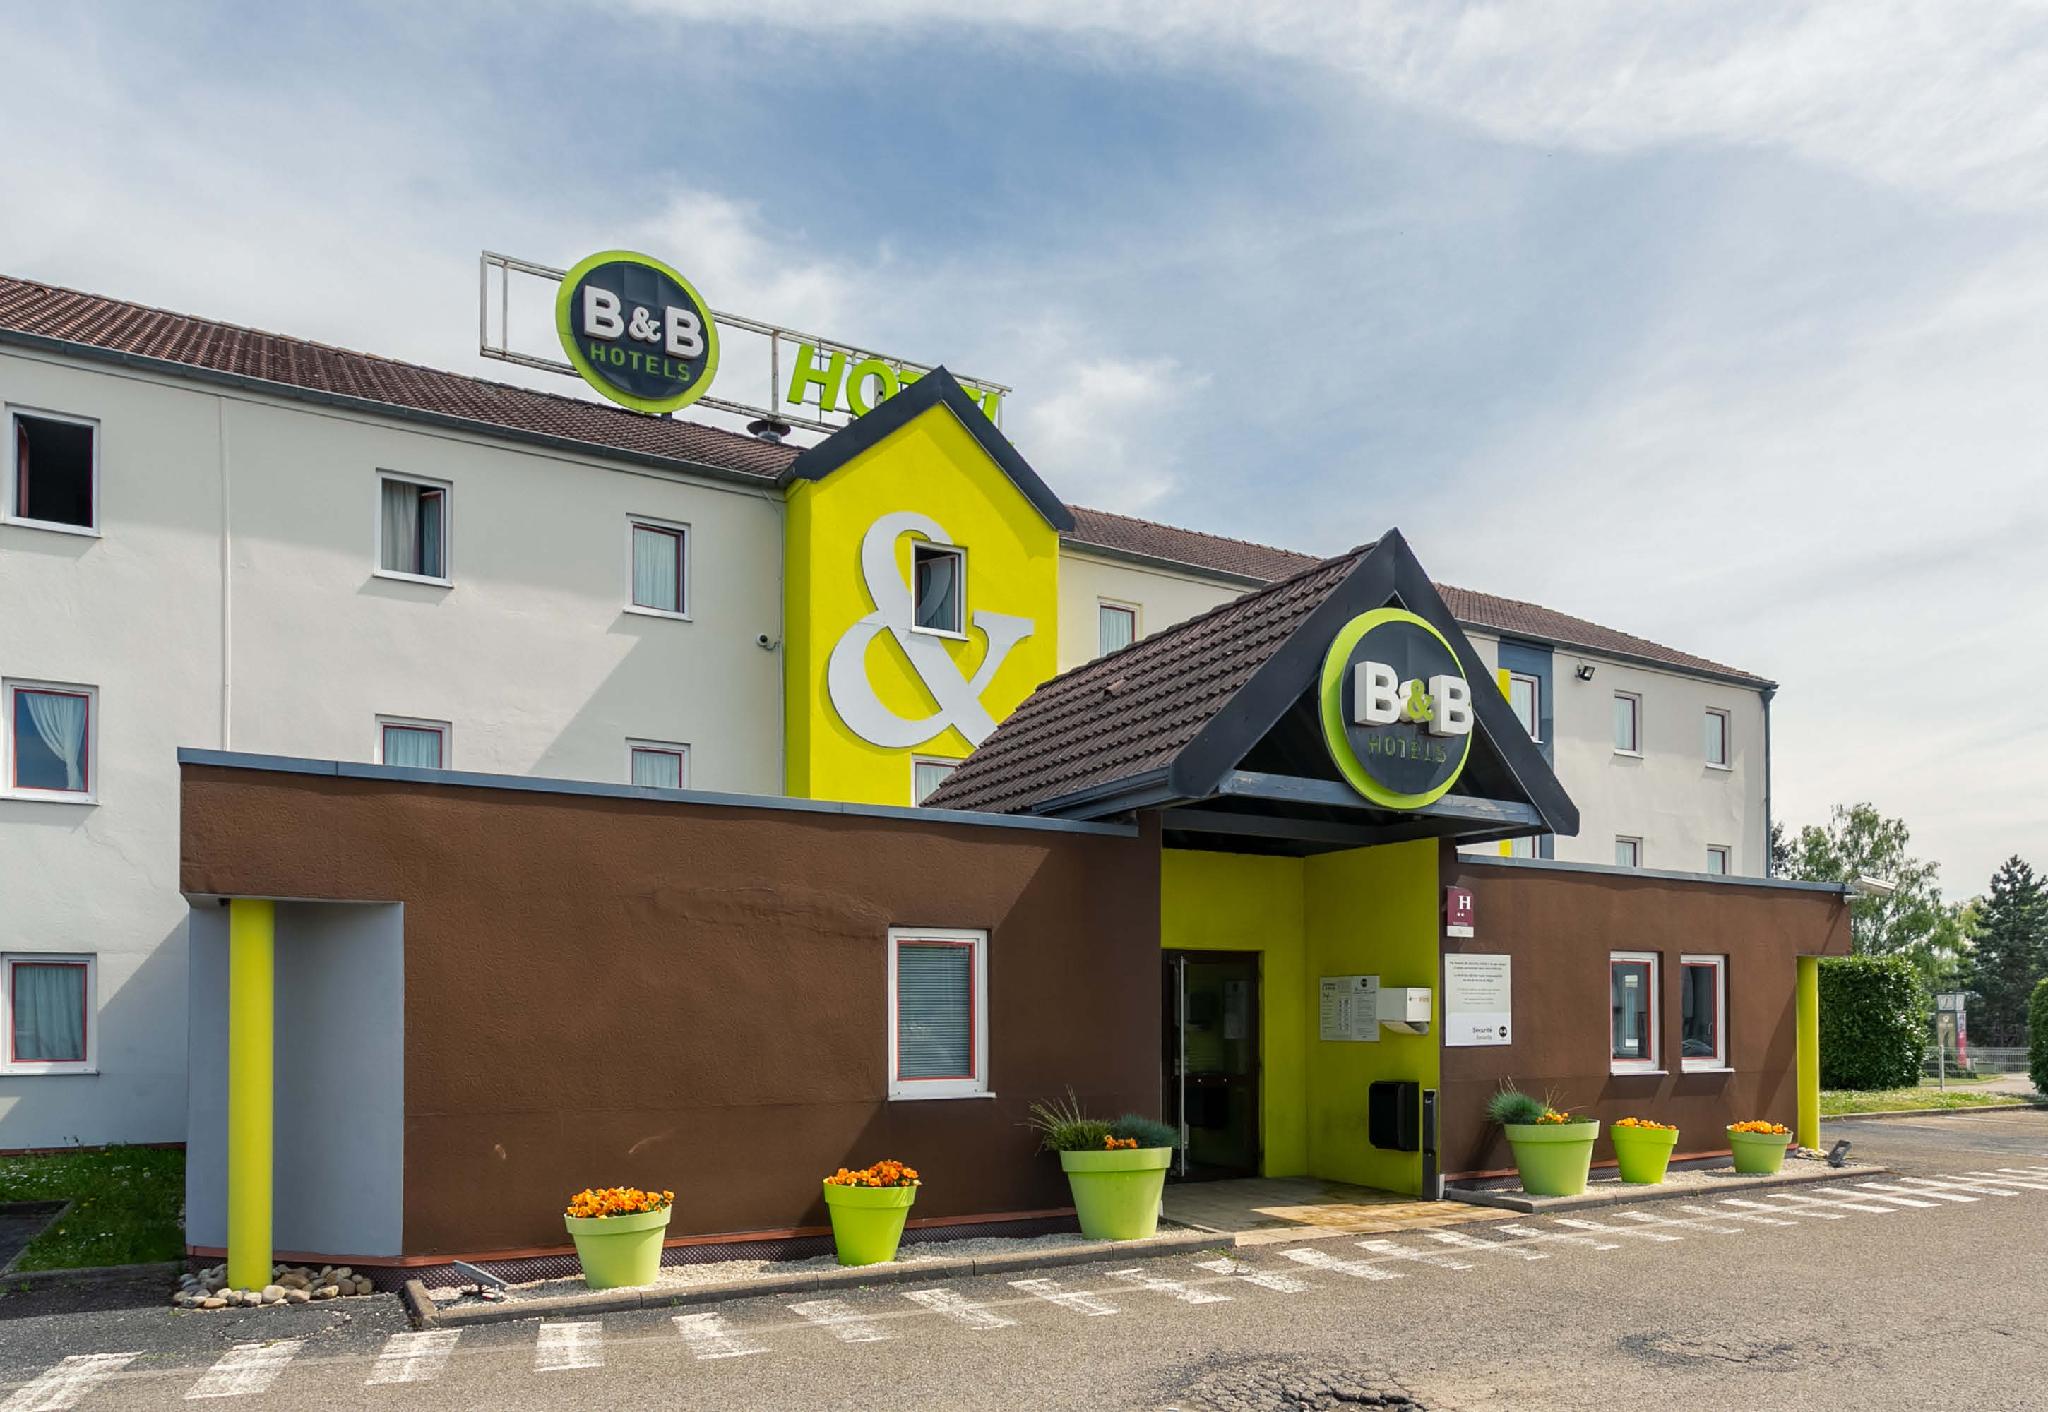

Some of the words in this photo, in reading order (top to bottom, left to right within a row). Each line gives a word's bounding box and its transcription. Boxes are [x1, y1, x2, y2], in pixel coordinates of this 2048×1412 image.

[583, 284, 703, 359] B&B
[589, 342, 691, 382] HOTELS
[1355, 661, 1475, 736] B&B
[1459, 895, 1471, 910] H
